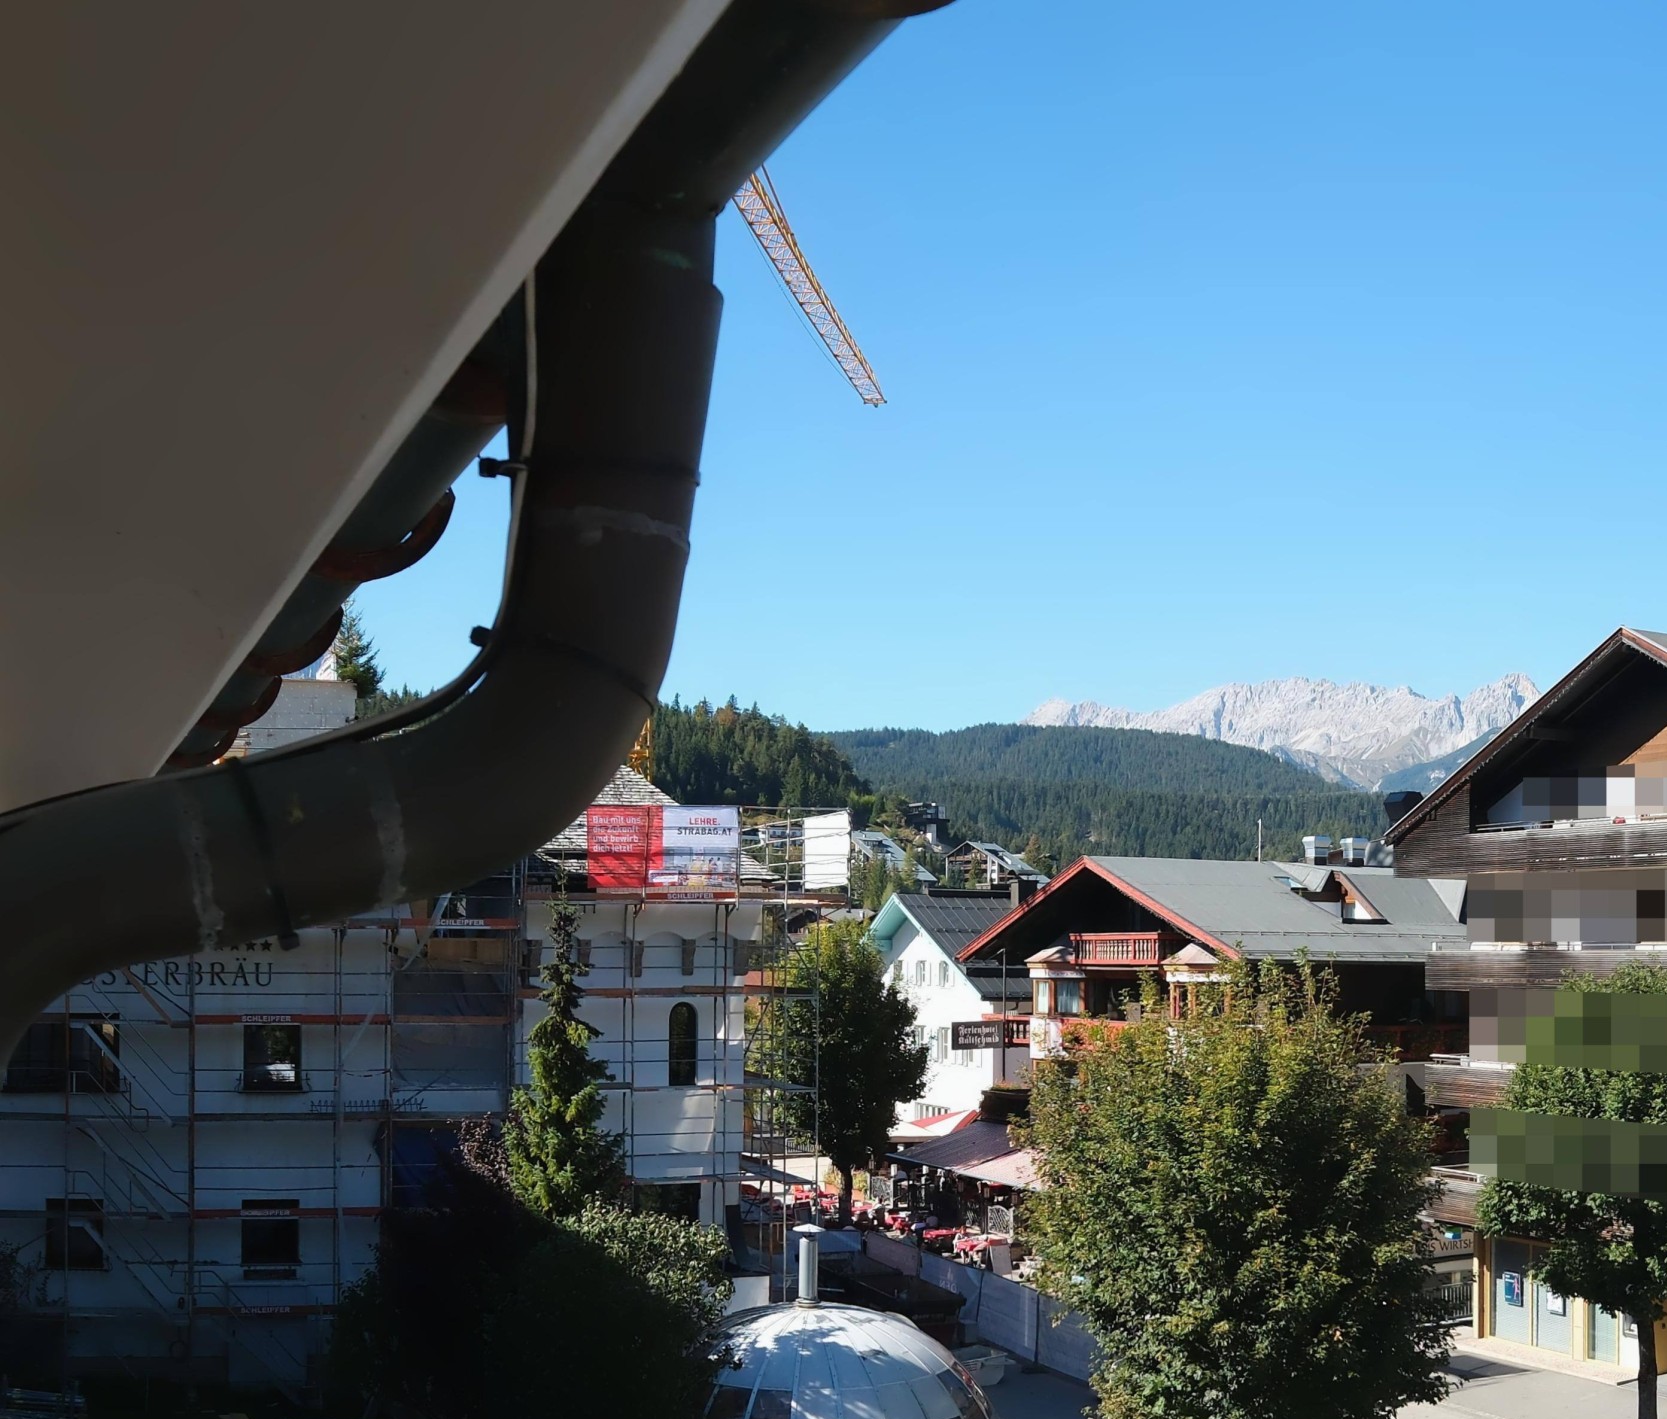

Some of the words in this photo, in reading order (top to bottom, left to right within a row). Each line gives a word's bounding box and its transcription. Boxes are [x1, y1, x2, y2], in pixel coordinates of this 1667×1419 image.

[626, 816, 641, 824] uns
[689, 817, 720, 826] LEHRE.
[677, 827, 732, 836] STRABAG.AT
